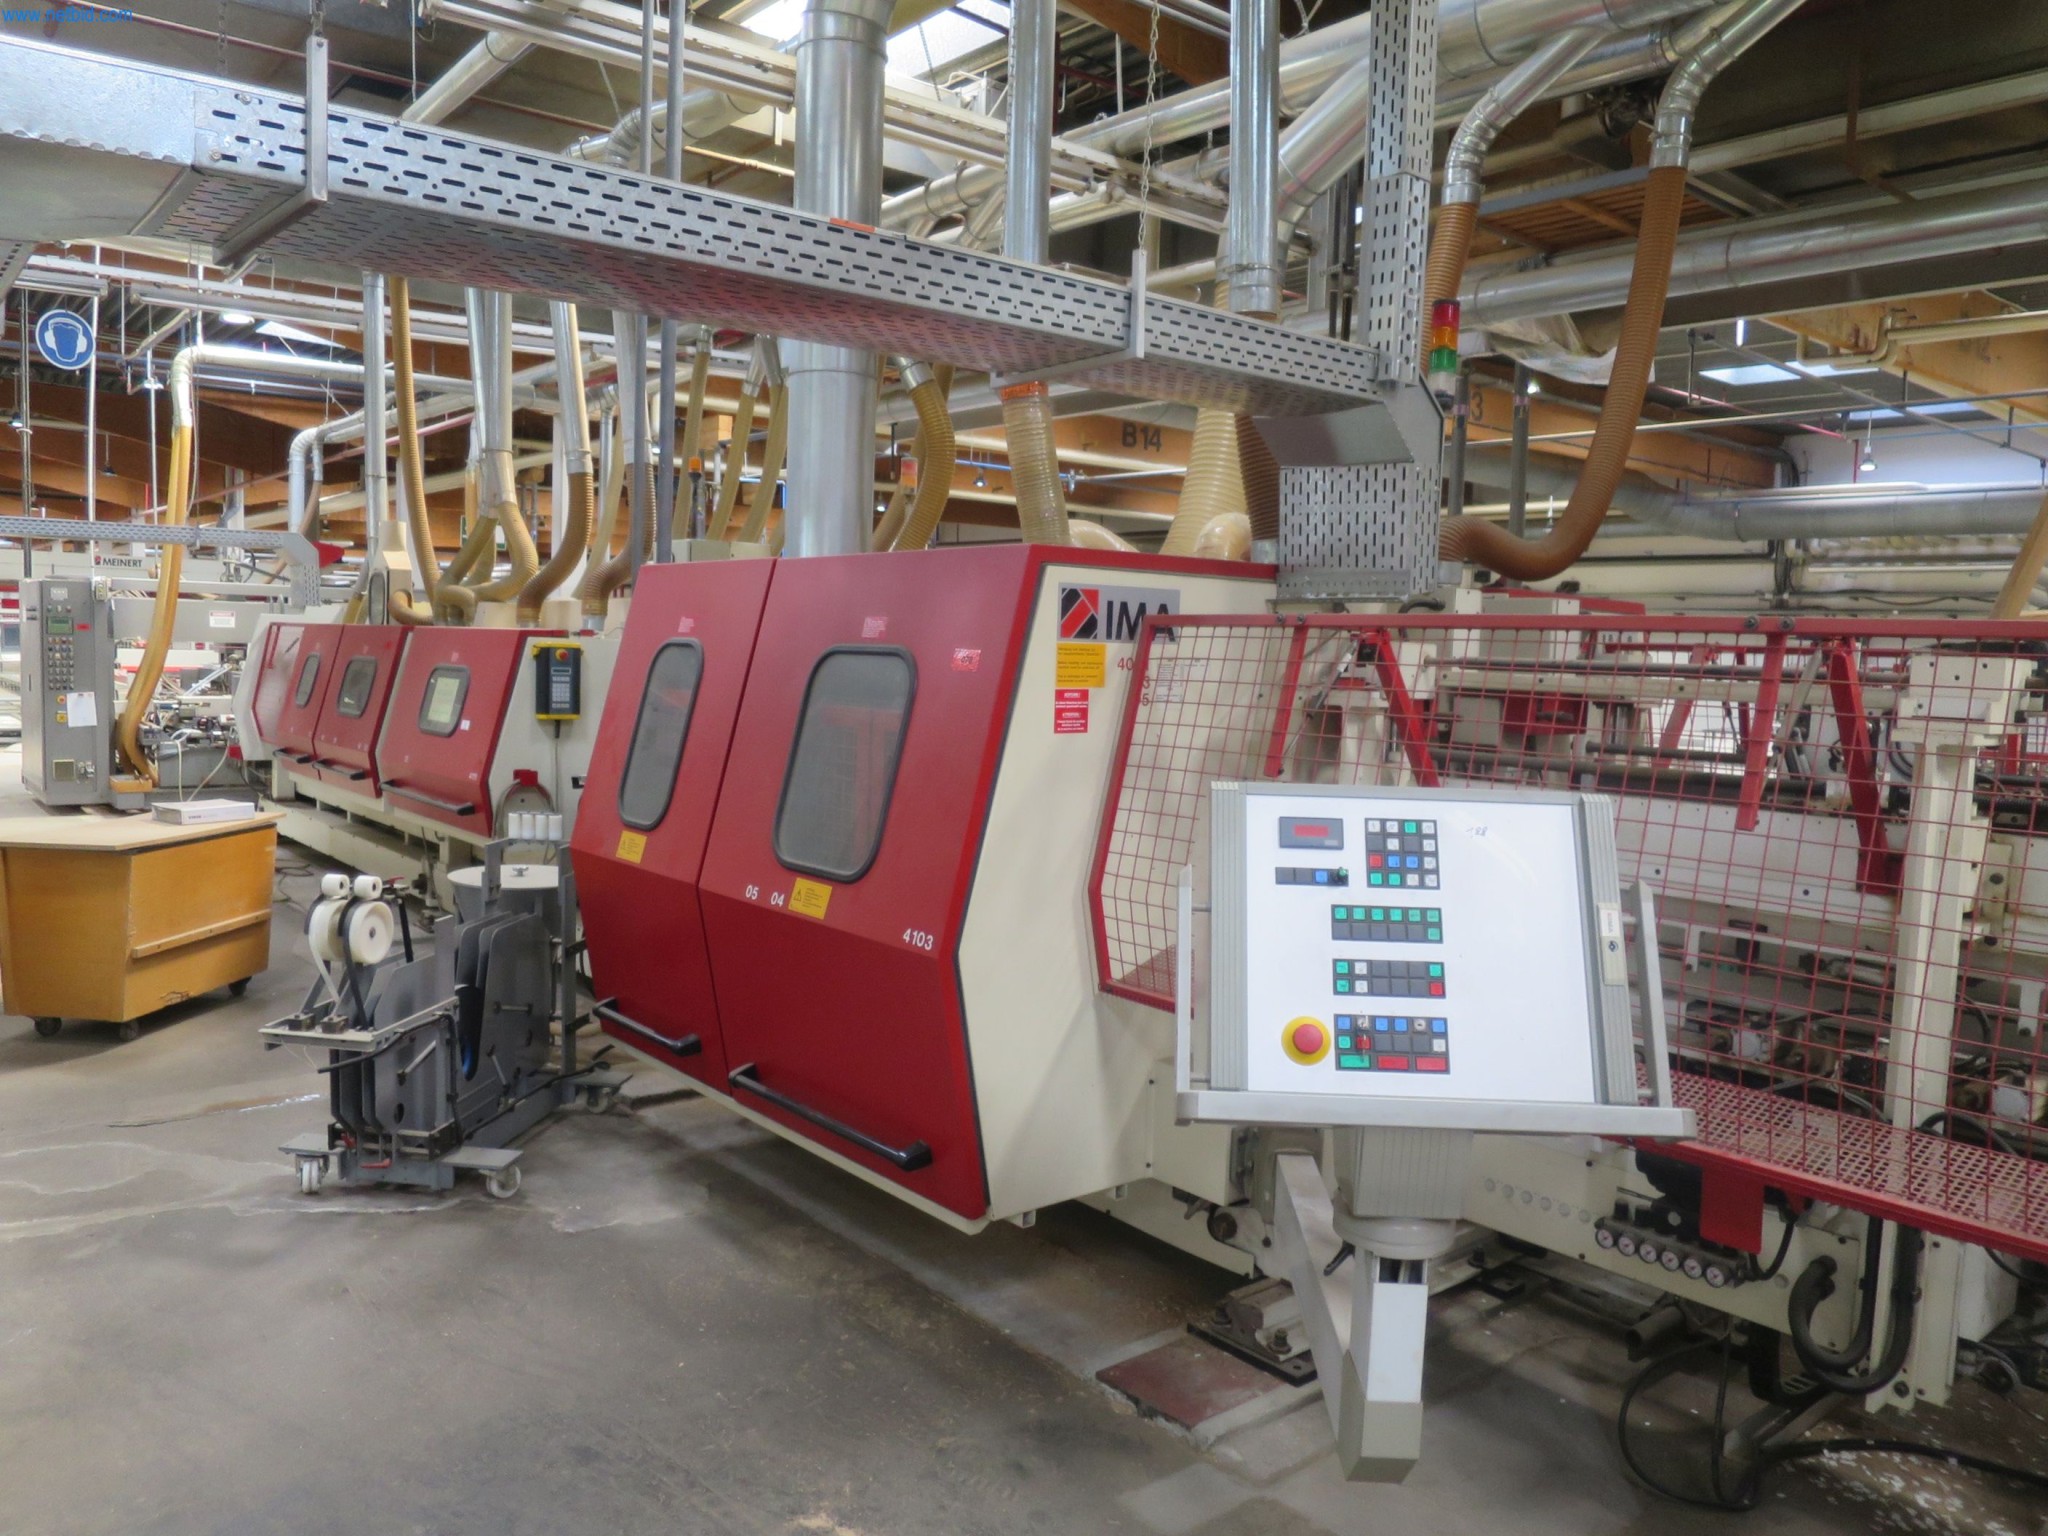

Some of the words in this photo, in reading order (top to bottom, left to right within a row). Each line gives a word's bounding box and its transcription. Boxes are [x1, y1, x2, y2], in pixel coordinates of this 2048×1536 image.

[102, 557, 143, 567] MEINERT
[1106, 600, 1176, 642] IMA
[745, 885, 759, 900] 05
[770, 892, 785, 907] 04
[903, 928, 934, 950] 4103
